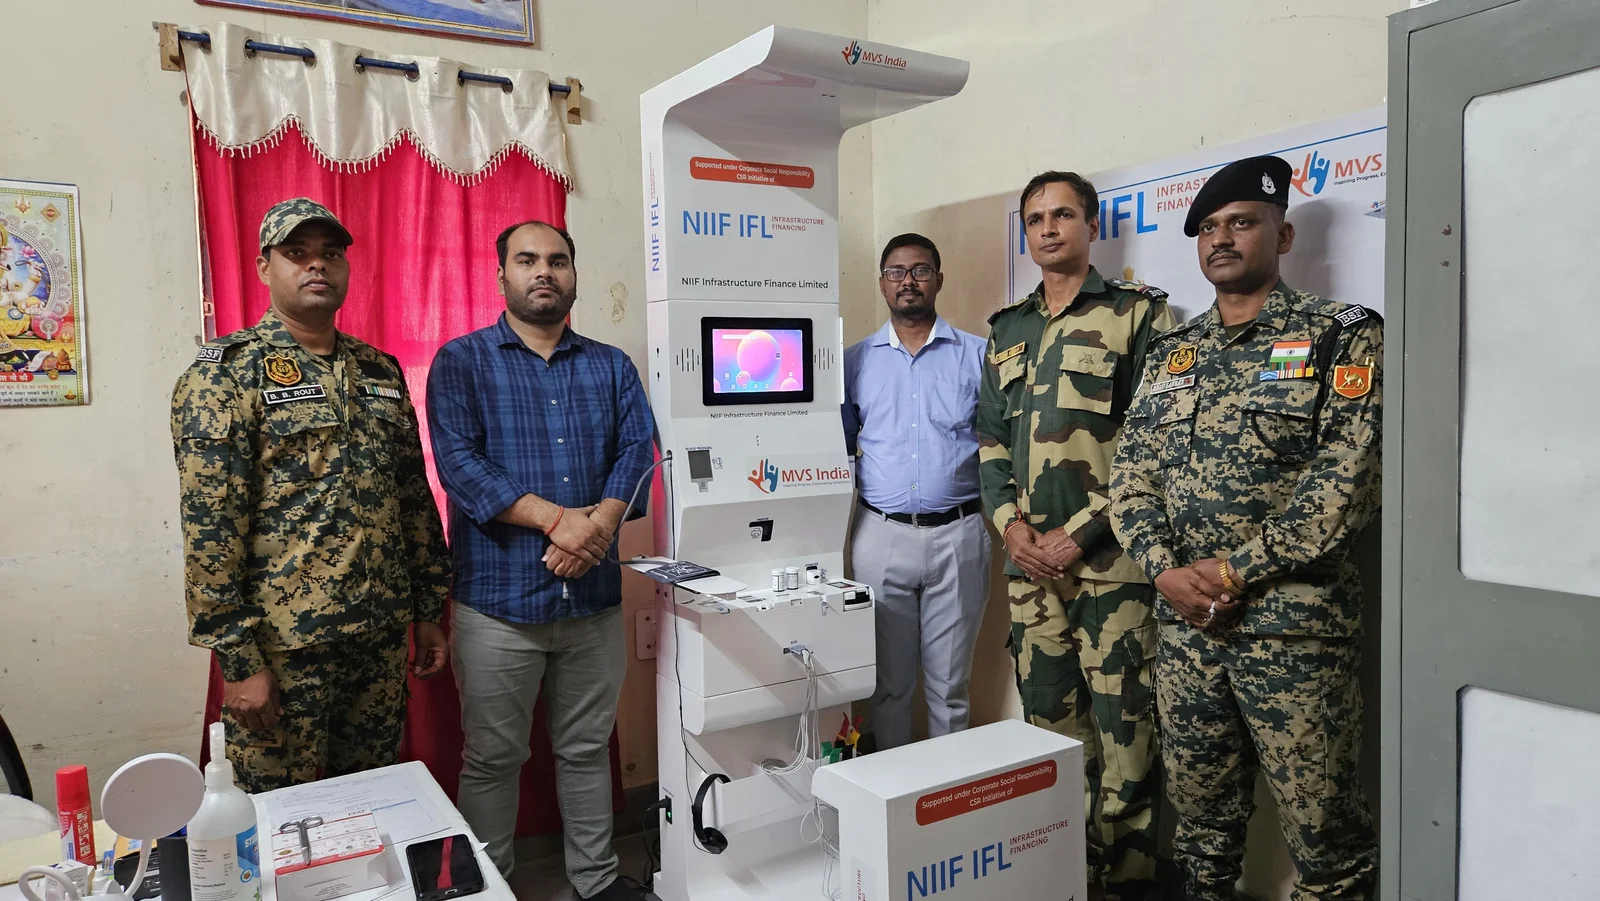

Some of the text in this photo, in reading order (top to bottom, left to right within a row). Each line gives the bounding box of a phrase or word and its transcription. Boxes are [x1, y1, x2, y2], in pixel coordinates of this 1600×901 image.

[862, 51, 883, 64] MVS
[885, 55, 907, 68] India
[694, 160, 722, 169] Supported
[738, 164, 763, 173] Corporate
[778, 168, 811, 178] Responsibility
[1335, 154, 1382, 178] MVS
[651, 197, 659, 226] IFL
[1157, 196, 1193, 212] FINAN
[683, 210, 773, 238] NIIF IFL
[772, 216, 824, 225] INFRASTRUCTURE
[1100, 192, 1158, 240] IFL
[682, 278, 828, 288] NIIF Infrastructure Finance Limited
[1340, 309, 1362, 322] BSF
[200, 348, 220, 359] BSF
[294, 389, 316, 397] ROUT
[782, 467, 850, 482] MVS India
[922, 766, 1053, 809] Supported under Corporate Social Responsibility
[970, 788, 1013, 807] CSR Initiative of
[1010, 819, 1068, 845] INFRASTRUCTURE
[1010, 836, 1048, 855] FINANCING
[907, 842, 1012, 901] NIIF IFL
